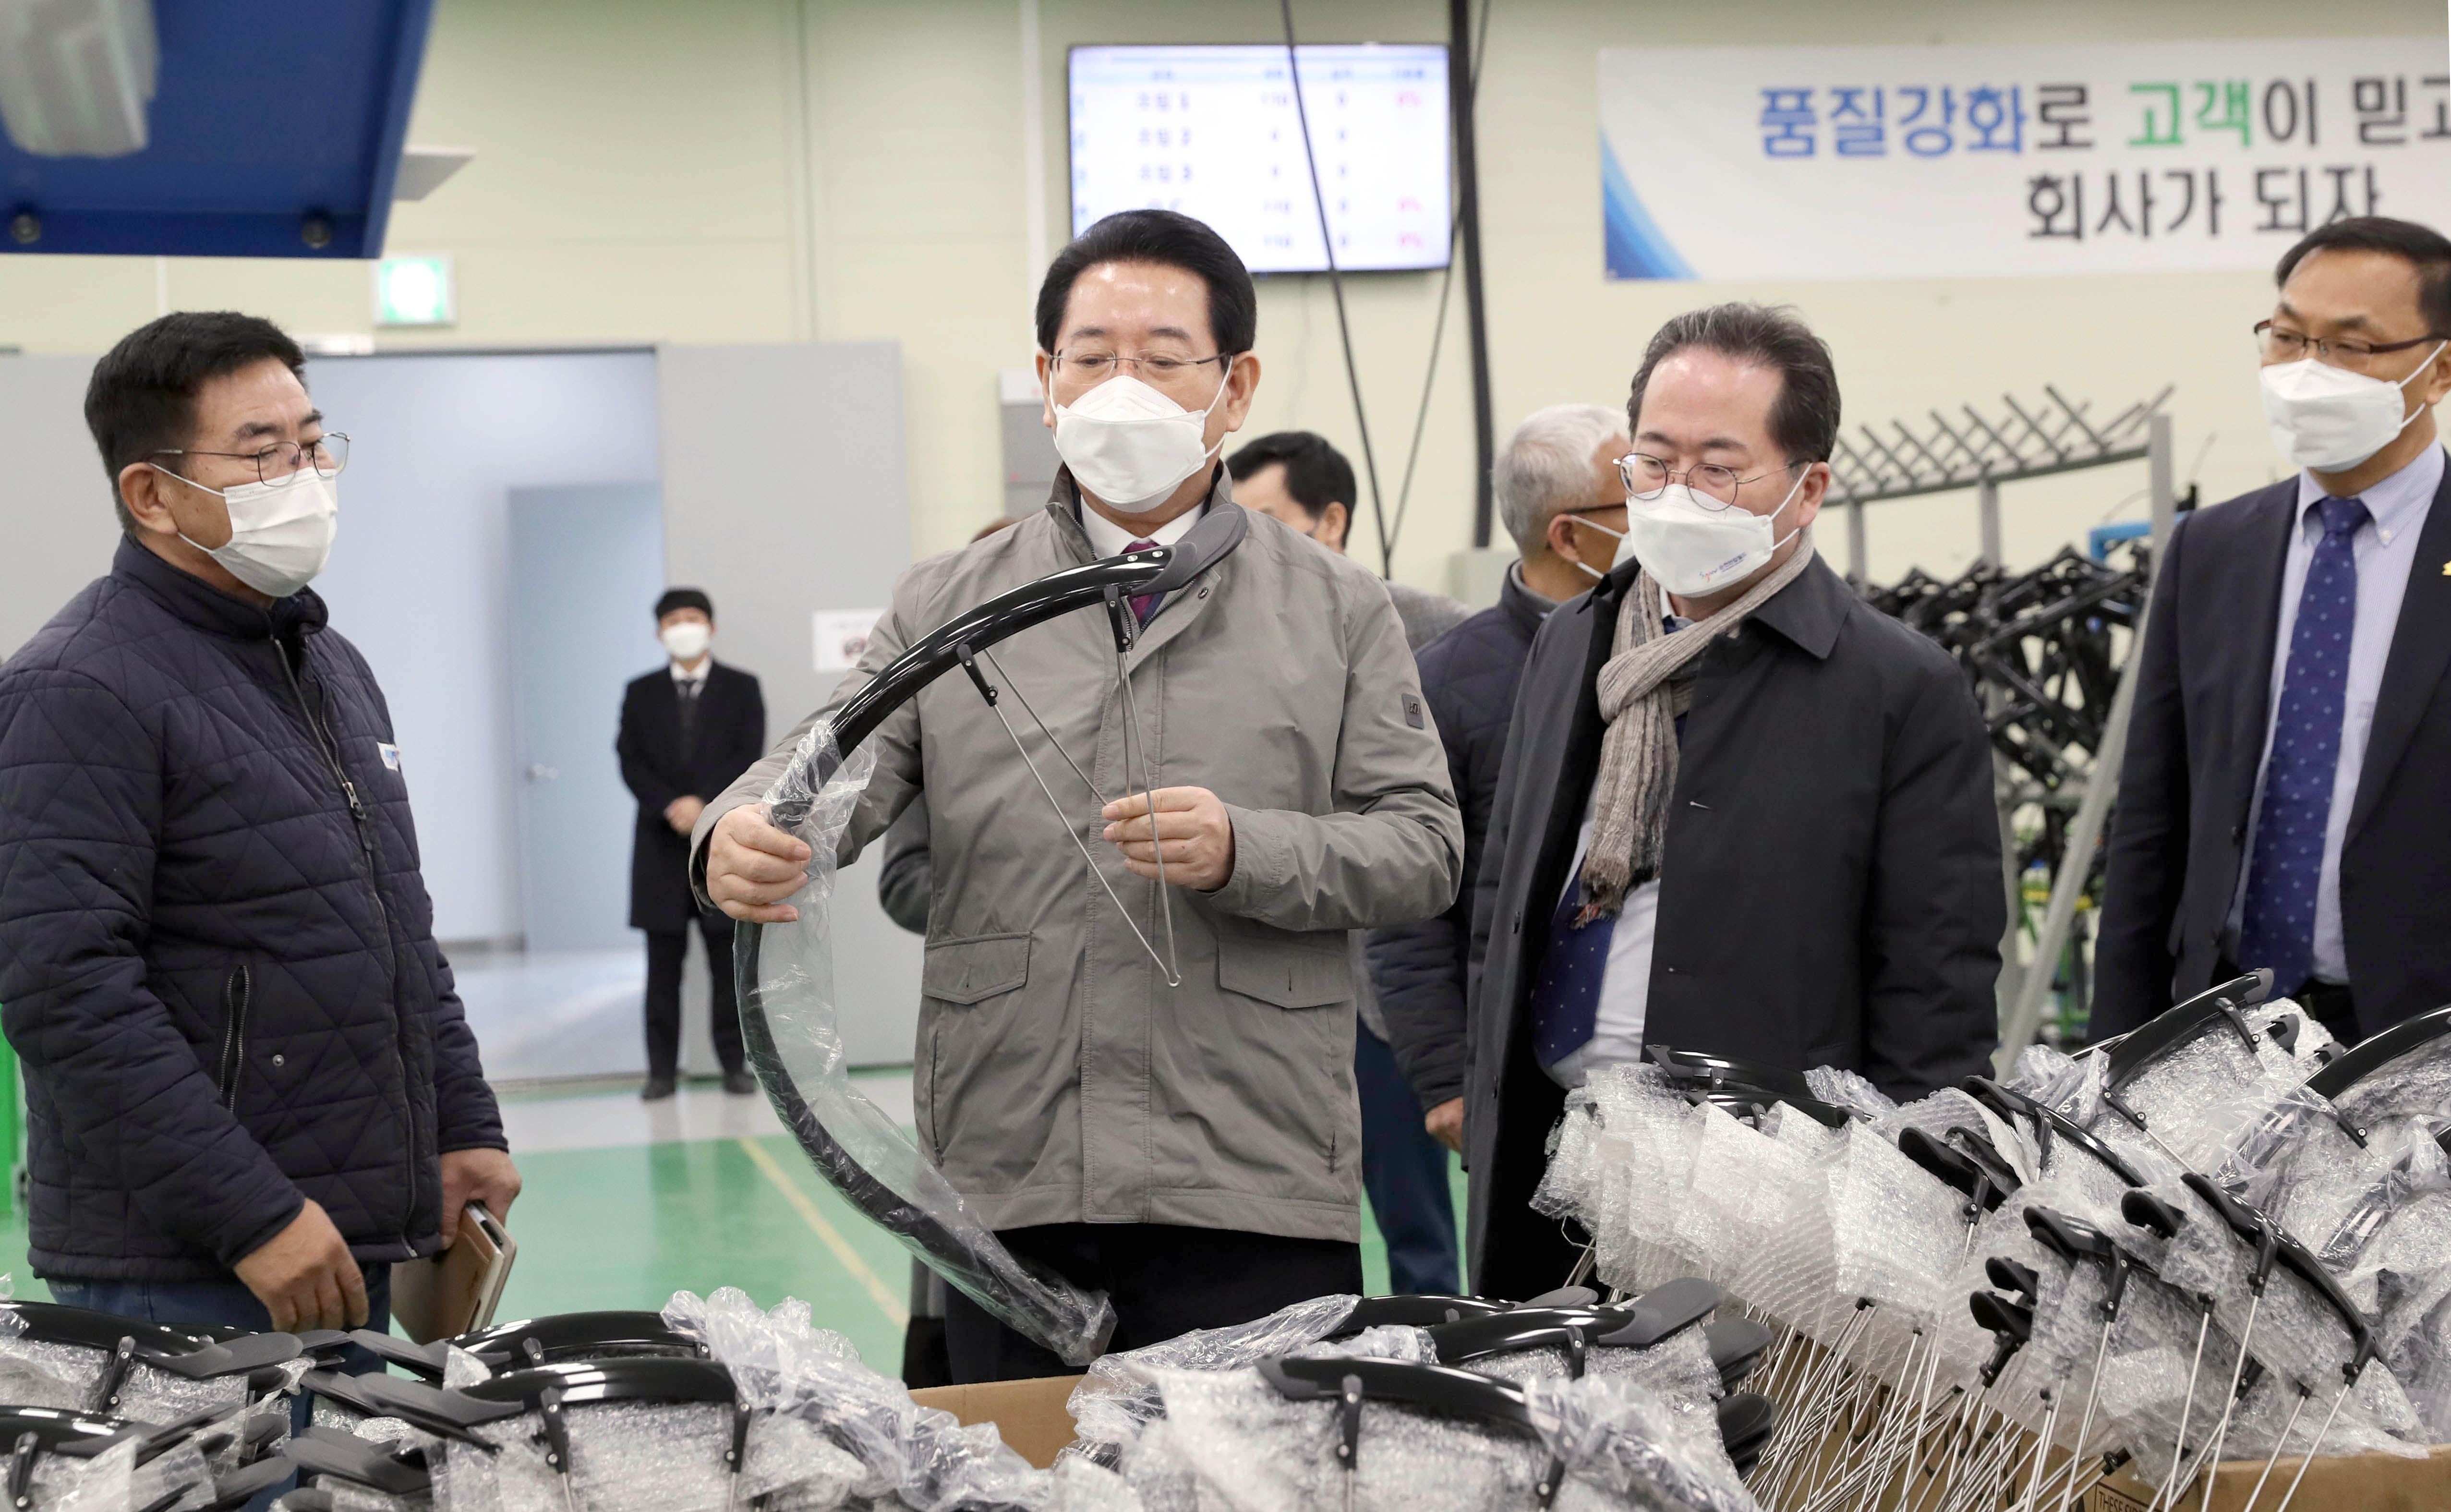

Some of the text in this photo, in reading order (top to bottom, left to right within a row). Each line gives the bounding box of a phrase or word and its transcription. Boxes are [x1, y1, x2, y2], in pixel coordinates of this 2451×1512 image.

[1759, 83, 2094, 157] 품질강화로
[2129, 78, 2316, 148] 고객이
[2026, 166, 2382, 241] 회사가 되자
